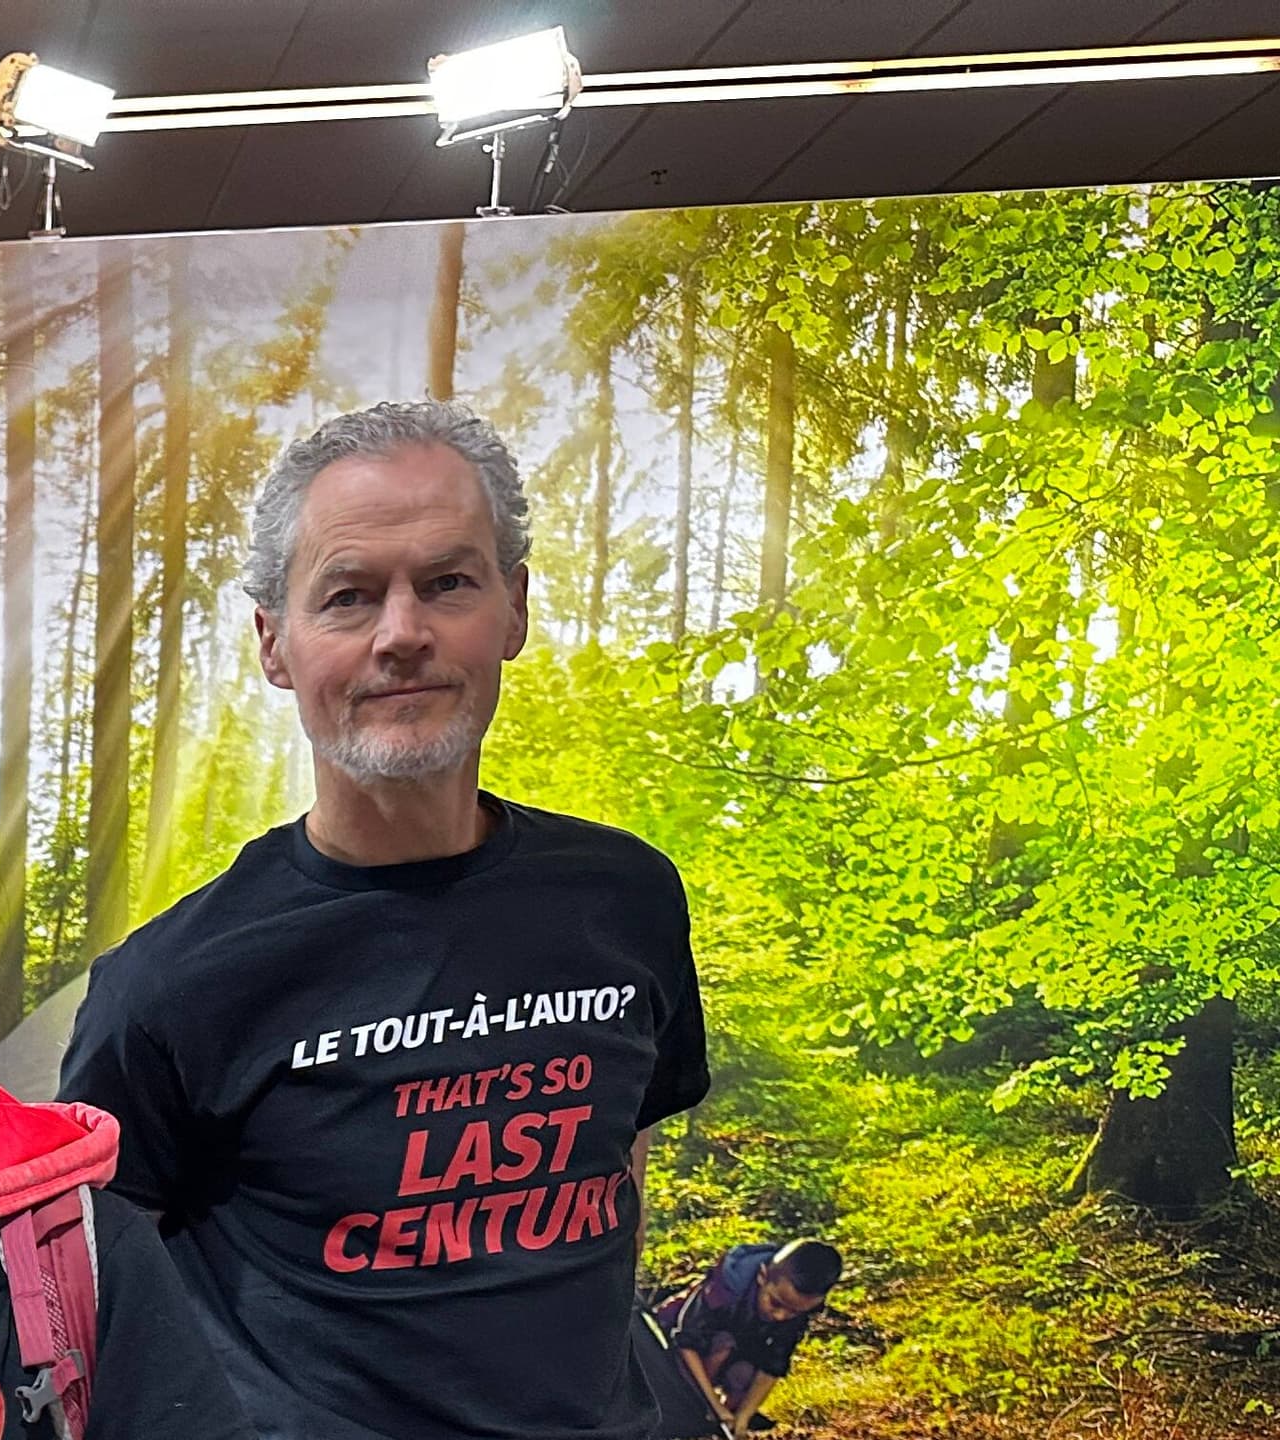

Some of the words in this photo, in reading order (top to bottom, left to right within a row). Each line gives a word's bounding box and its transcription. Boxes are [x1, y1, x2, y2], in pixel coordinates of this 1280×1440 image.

[291, 1030, 342, 1070] LE
[350, 984, 636, 1058] TOUT-À-L'AUTO?
[394, 1062, 534, 1118] THAT'S
[541, 1054, 593, 1095] SO
[397, 1105, 593, 1197] LAST
